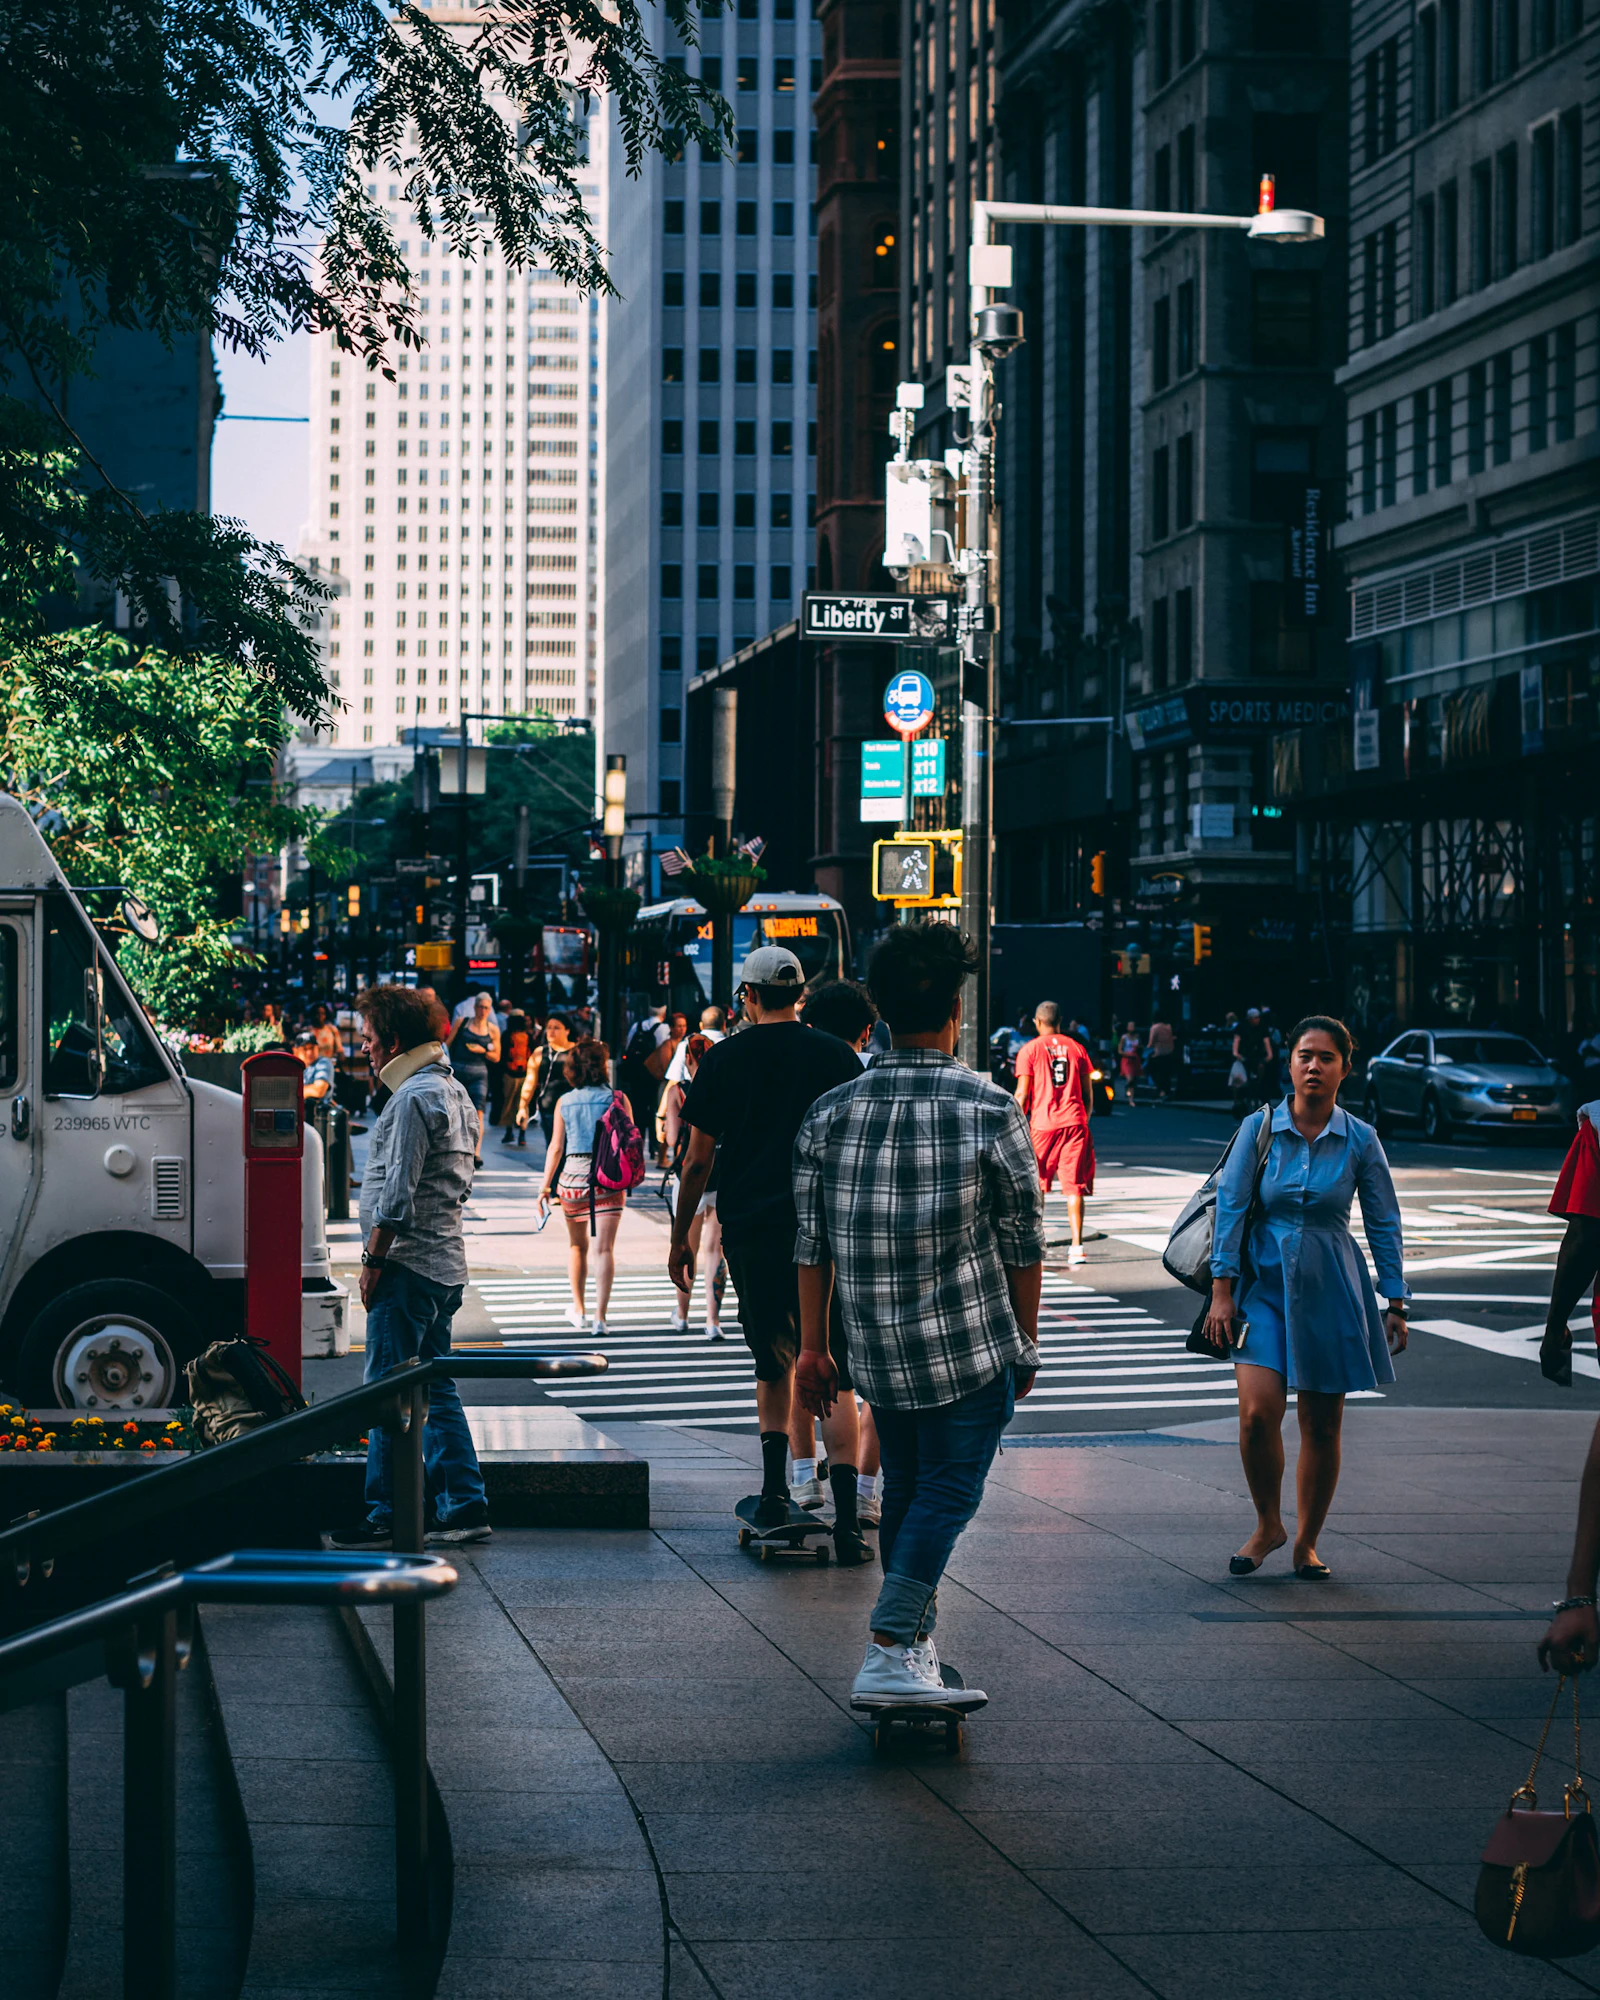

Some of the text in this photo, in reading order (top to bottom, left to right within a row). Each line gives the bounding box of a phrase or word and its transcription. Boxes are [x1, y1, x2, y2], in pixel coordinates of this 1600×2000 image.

[1305, 488, 1320, 615] Residence Inn
[811, 604, 904, 634] Liberty ST
[1209, 700, 1271, 722] SPORTS
[914, 741, 938, 757] x10
[914, 760, 936, 775] x11
[914, 778, 937, 793] x12
[54, 1116, 151, 1130] 239965 WTC
